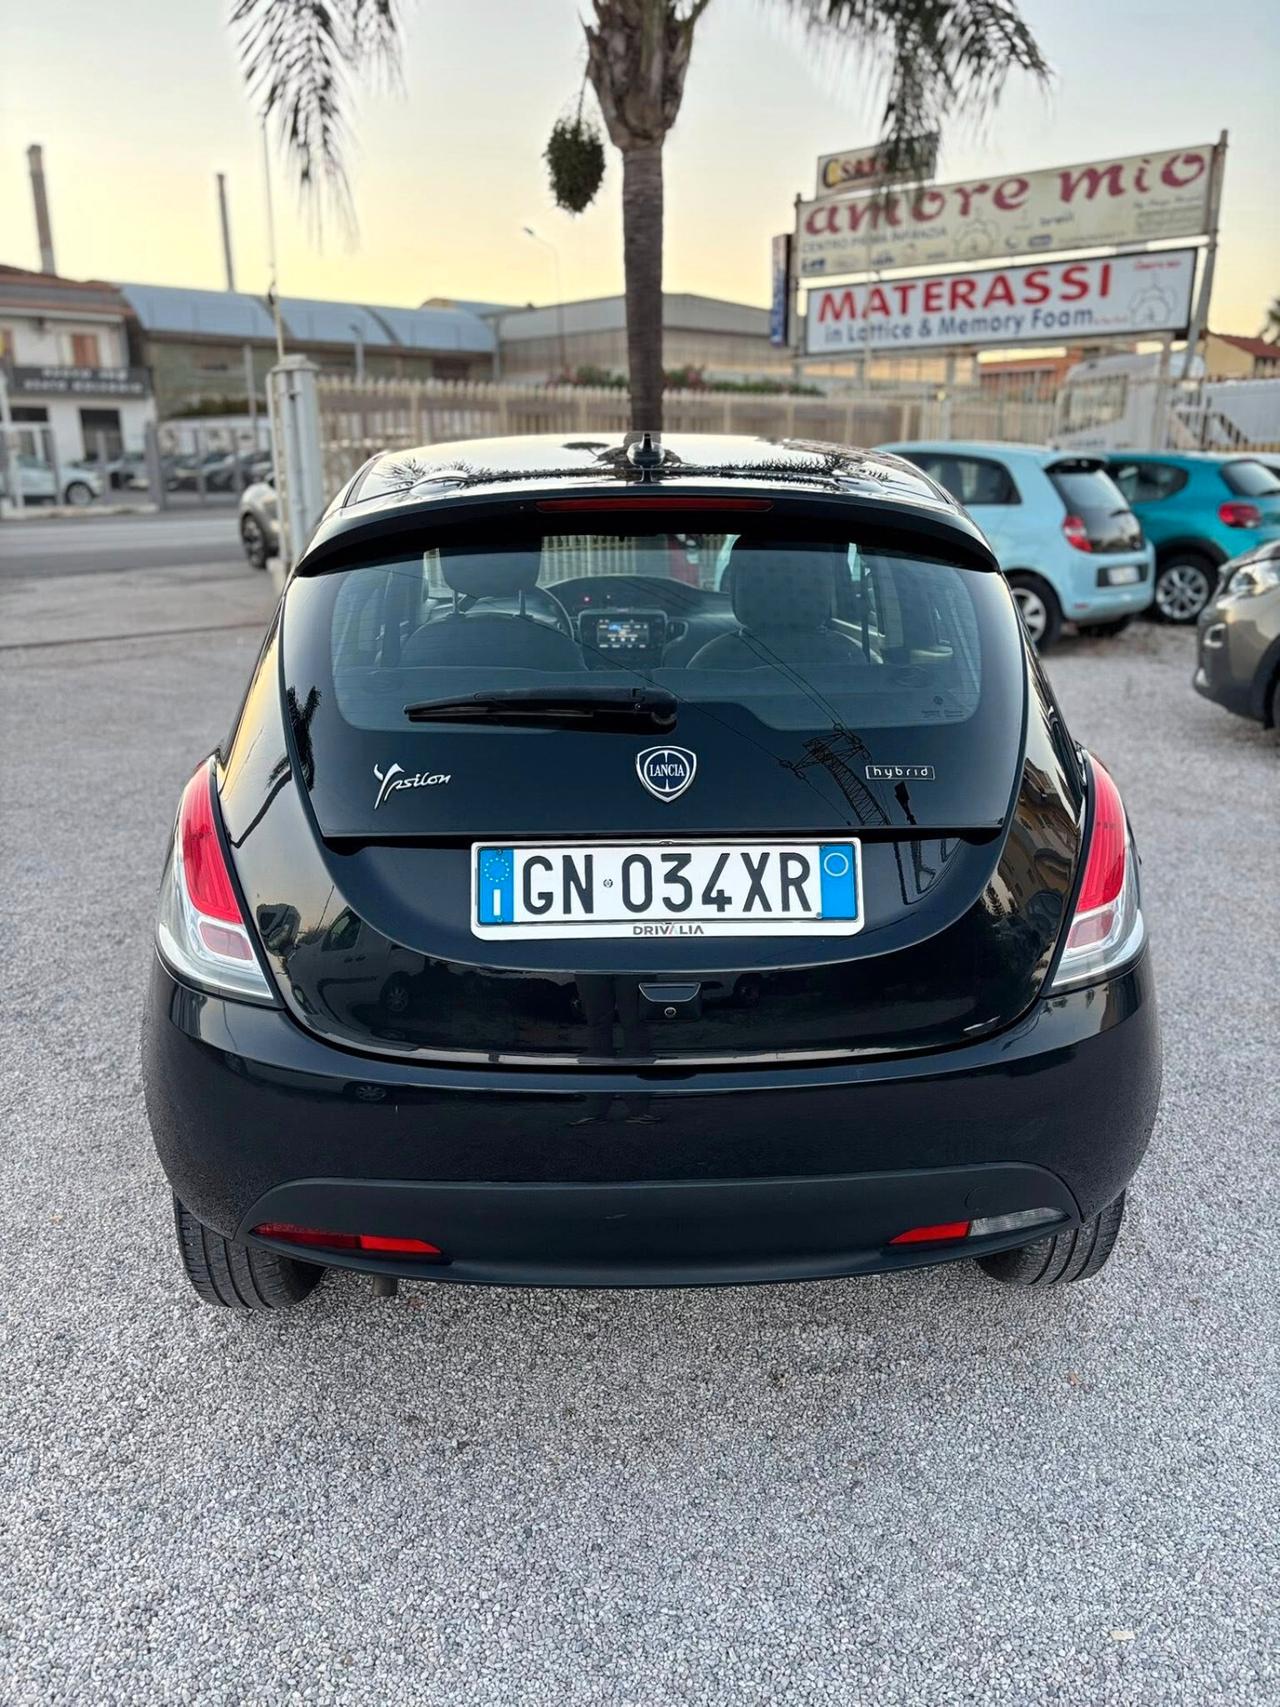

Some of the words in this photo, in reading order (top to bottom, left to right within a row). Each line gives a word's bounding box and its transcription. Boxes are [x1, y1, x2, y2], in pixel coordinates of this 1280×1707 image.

[805, 177, 1029, 235] amore
[1058, 153, 1205, 203] mio
[818, 263, 1111, 323] MATERASSI
[825, 326, 843, 343] in
[918, 319, 932, 338] &
[937, 313, 1025, 337] Memory
[373, 763, 451, 810] Ypsilon
[649, 763, 686, 778] LANCIA
[873, 766, 928, 779] hybrid
[522, 854, 594, 915] GN
[621, 852, 813, 912] 034XR
[632, 924, 705, 936] DRIVALIA
